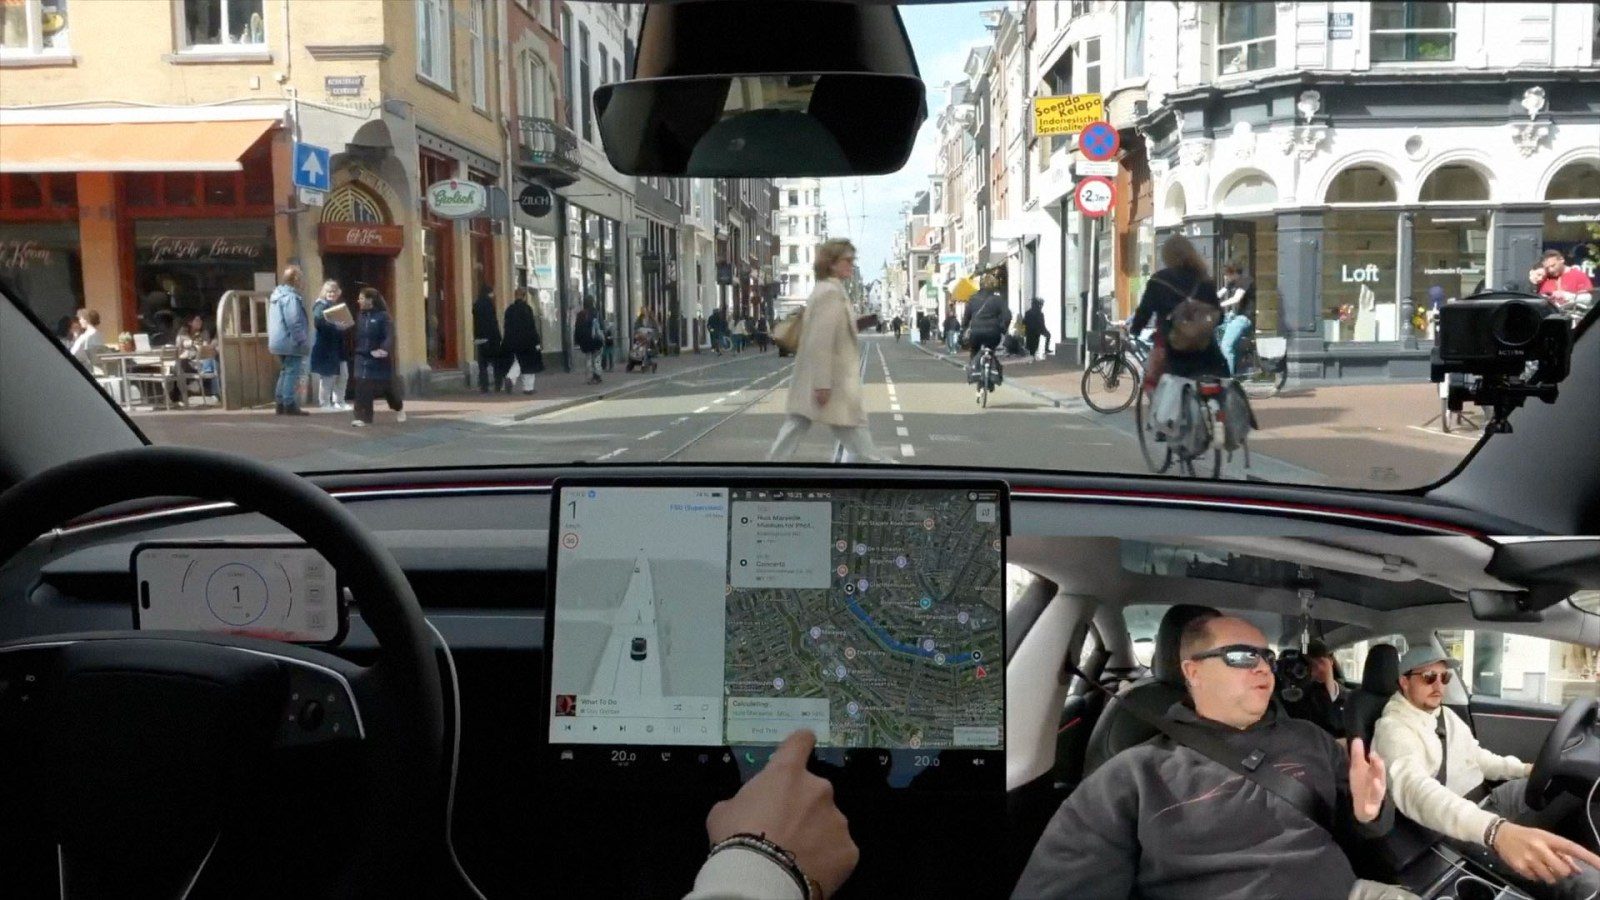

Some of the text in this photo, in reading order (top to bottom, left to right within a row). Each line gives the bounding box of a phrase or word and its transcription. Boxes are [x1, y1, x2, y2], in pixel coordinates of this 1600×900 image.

[1035, 96, 1080, 117] Soenda
[1059, 98, 1101, 117] Kelapa
[1038, 124, 1083, 134] Specialite
[1039, 115, 1100, 126] Indonesische
[433, 189, 476, 207] Grolsch
[521, 195, 550, 206] ZILCH
[1342, 263, 1379, 282] Loft
[568, 500, 577, 519] 1
[232, 585, 241, 604] 1
[611, 750, 637, 762] 20.0
[914, 755, 940, 767] 20.0
